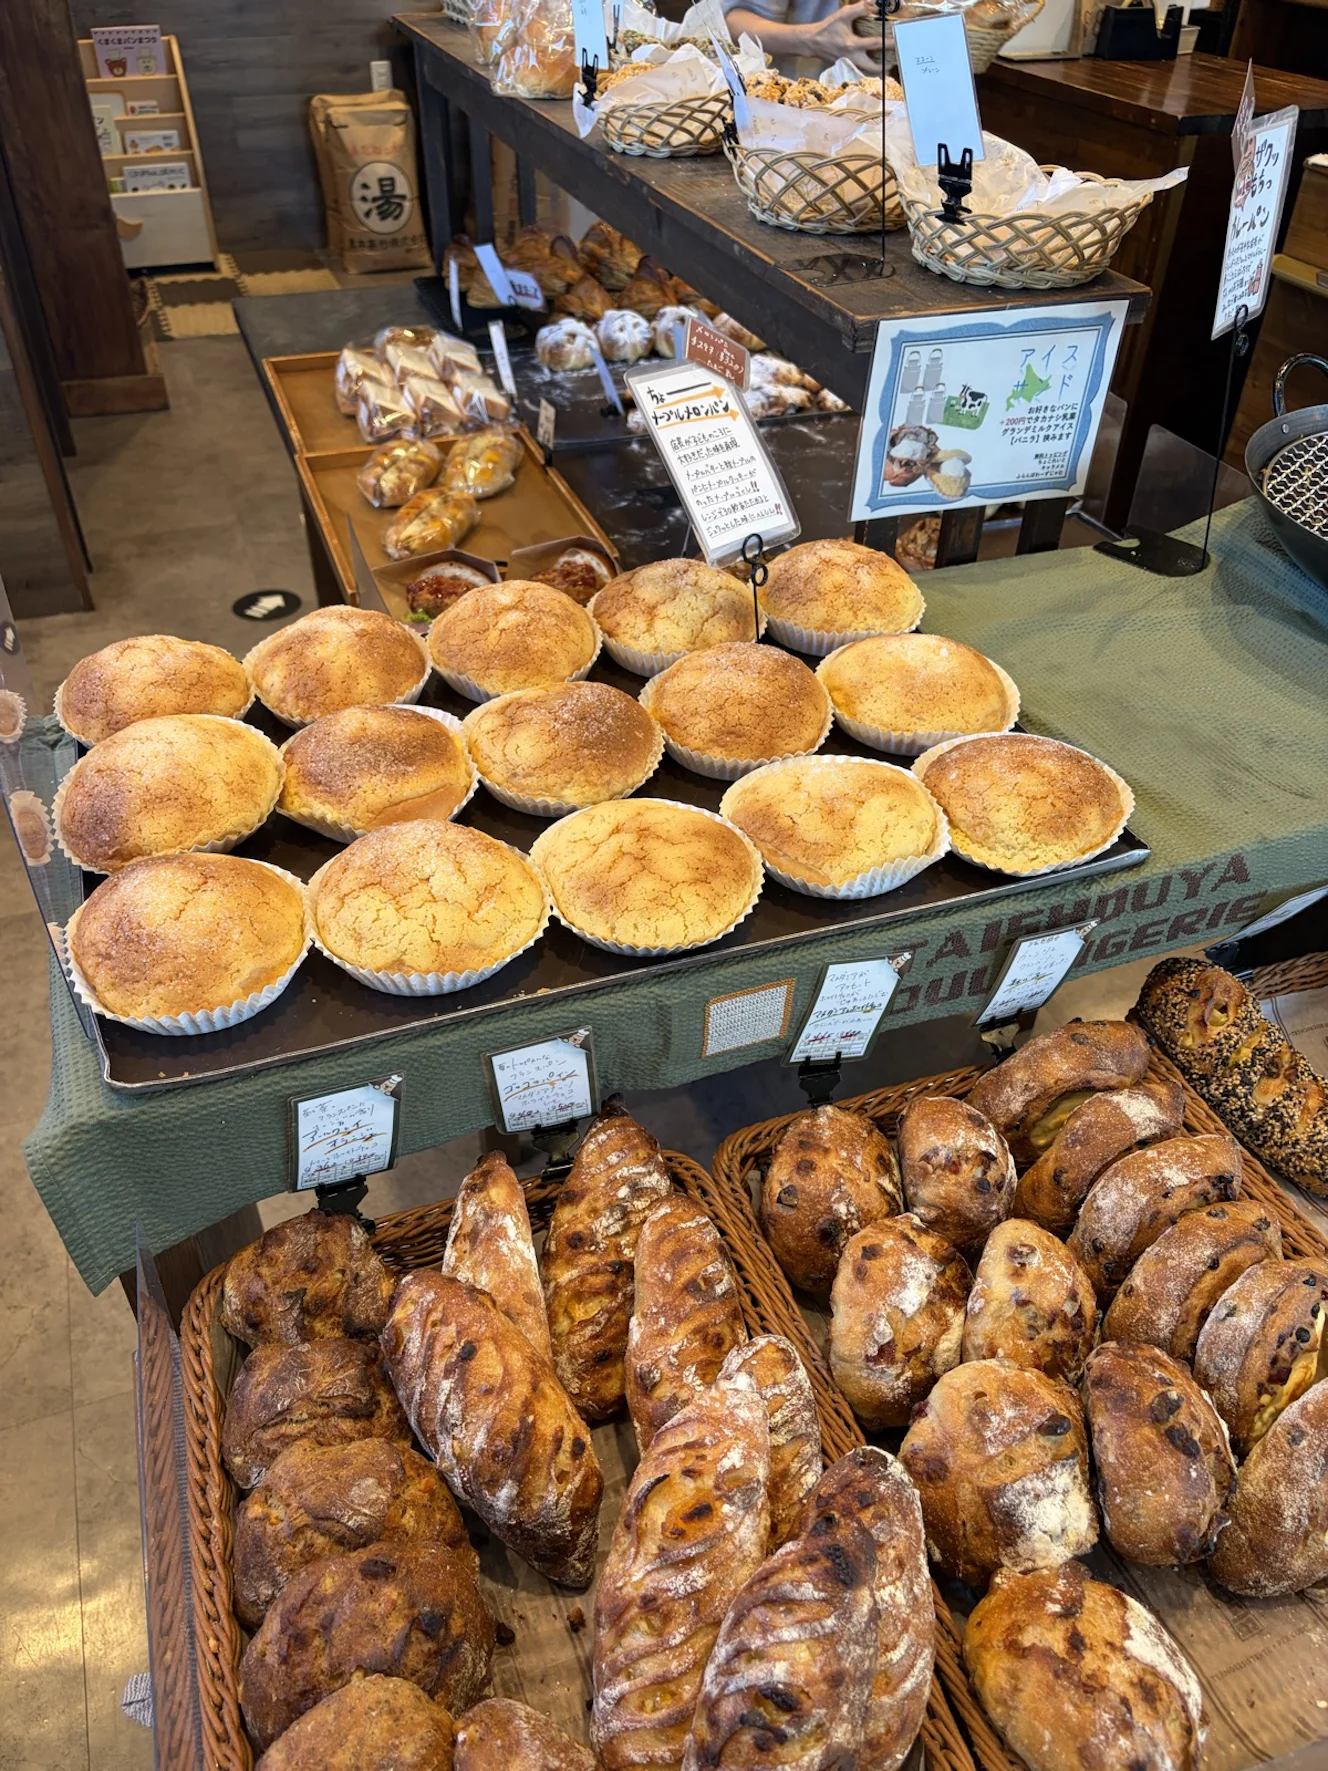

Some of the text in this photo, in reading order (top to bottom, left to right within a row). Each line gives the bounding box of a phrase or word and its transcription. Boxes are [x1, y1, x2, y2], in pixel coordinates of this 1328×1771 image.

[361, 177, 407, 220] 湯
[1020, 344, 1079, 373] アイス
[652, 400, 730, 426] メープルメロンパン
